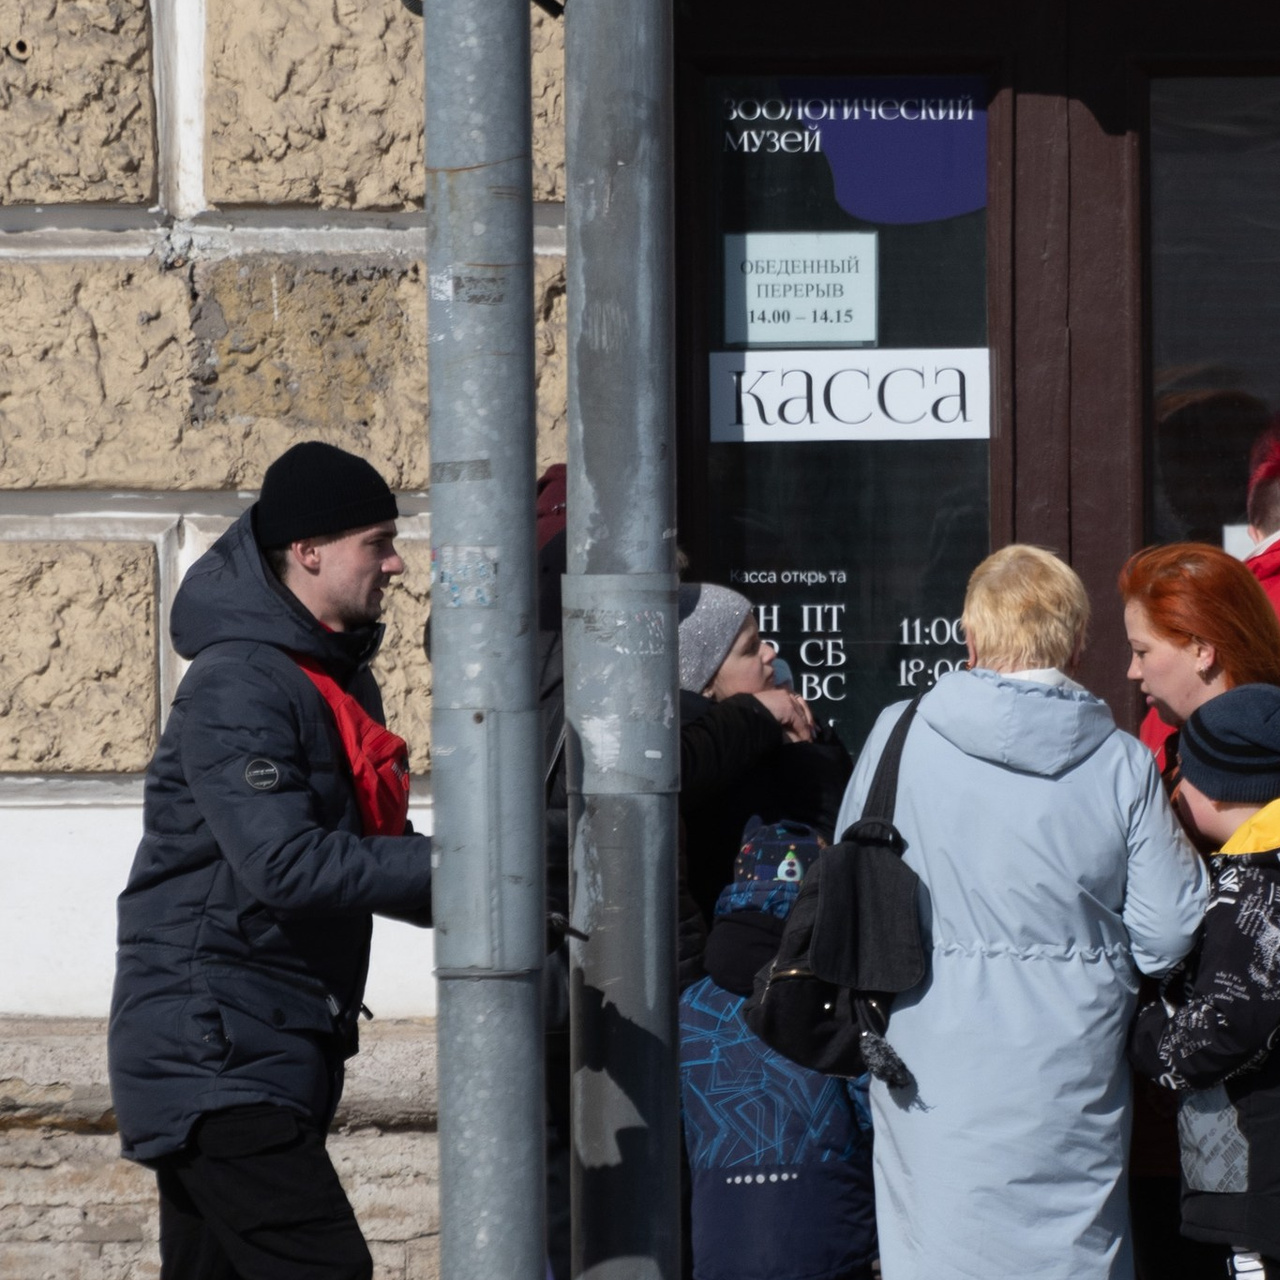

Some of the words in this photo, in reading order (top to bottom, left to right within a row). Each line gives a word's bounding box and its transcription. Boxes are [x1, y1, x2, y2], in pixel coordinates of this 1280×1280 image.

[740, 256, 860, 276] ОБЕДЕННЫЙ
[757, 283, 845, 298] ПЕРЕРЫВ
[748, 309, 791, 324] 14.00
[812, 309, 853, 324] 14.15
[754, 604, 780, 633] Н
[801, 604, 846, 632] ПТ
[800, 639, 846, 667] СБ
[801, 673, 846, 701] ВС
